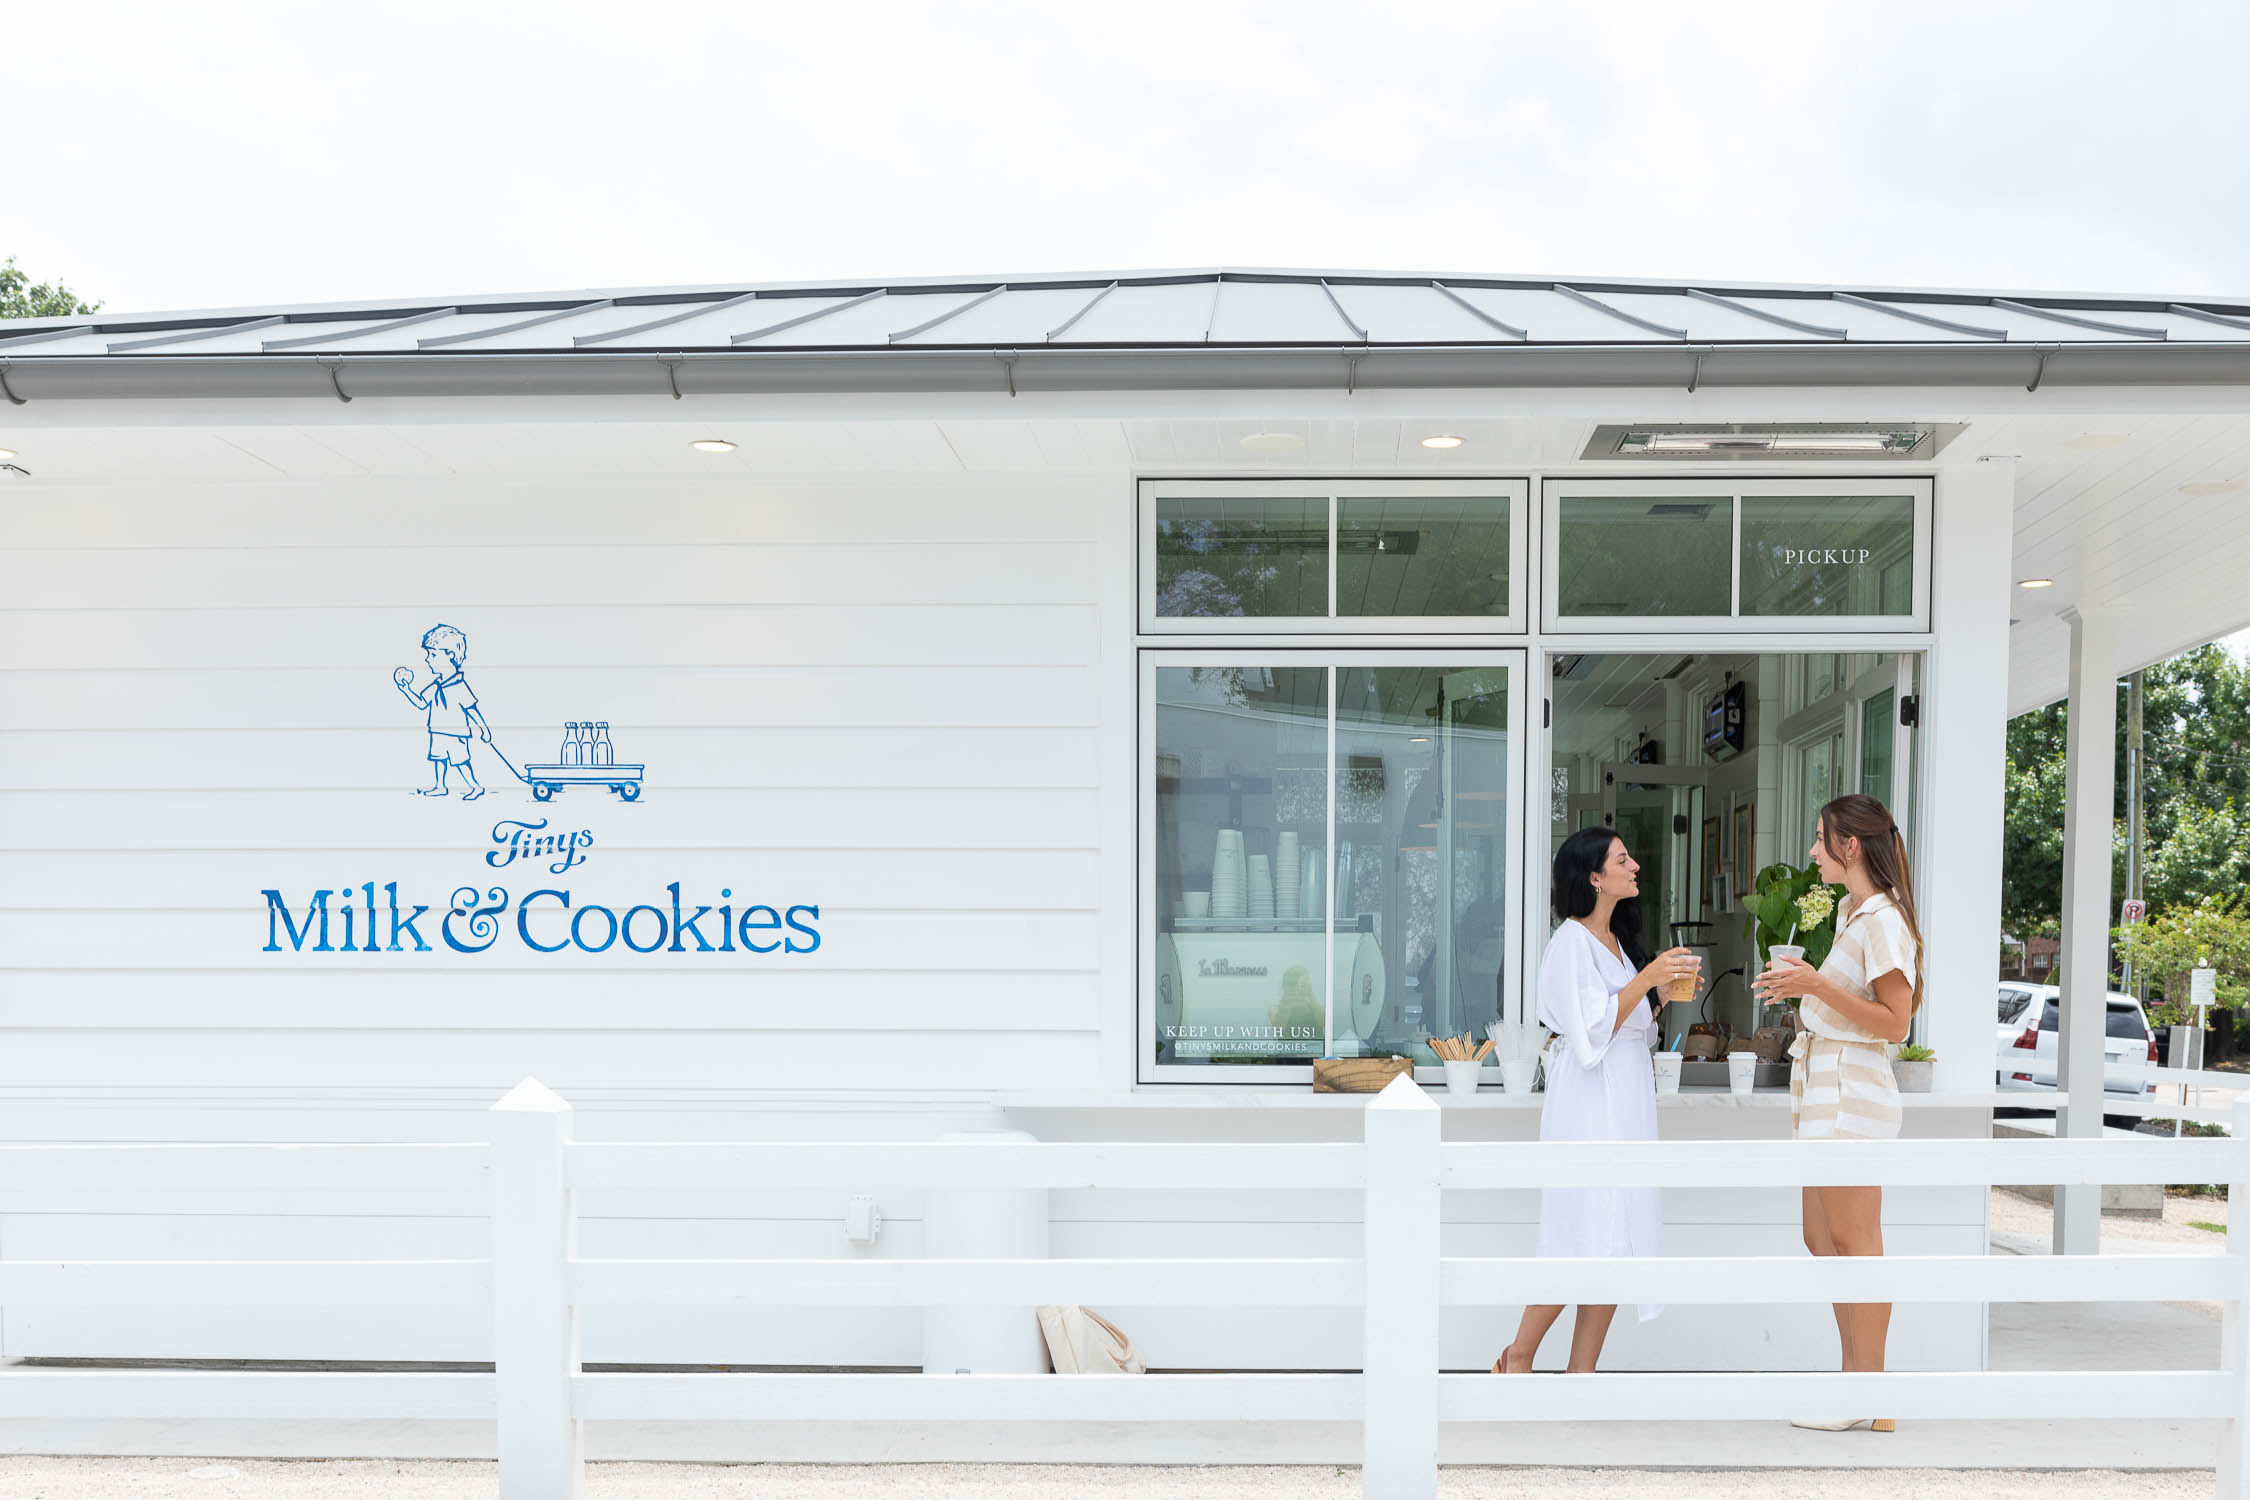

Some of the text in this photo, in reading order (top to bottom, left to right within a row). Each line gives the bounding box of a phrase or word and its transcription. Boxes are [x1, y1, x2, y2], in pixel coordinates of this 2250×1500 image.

[1784, 549, 1870, 564] PICKUP
[485, 816, 595, 875] Tinys
[260, 880, 822, 955] Milk & Cookies
[1166, 1025, 1316, 1038] KEEP UP WITH US!
[1174, 1042, 1307, 1052] @TINYSMILKANDCOOKIES
